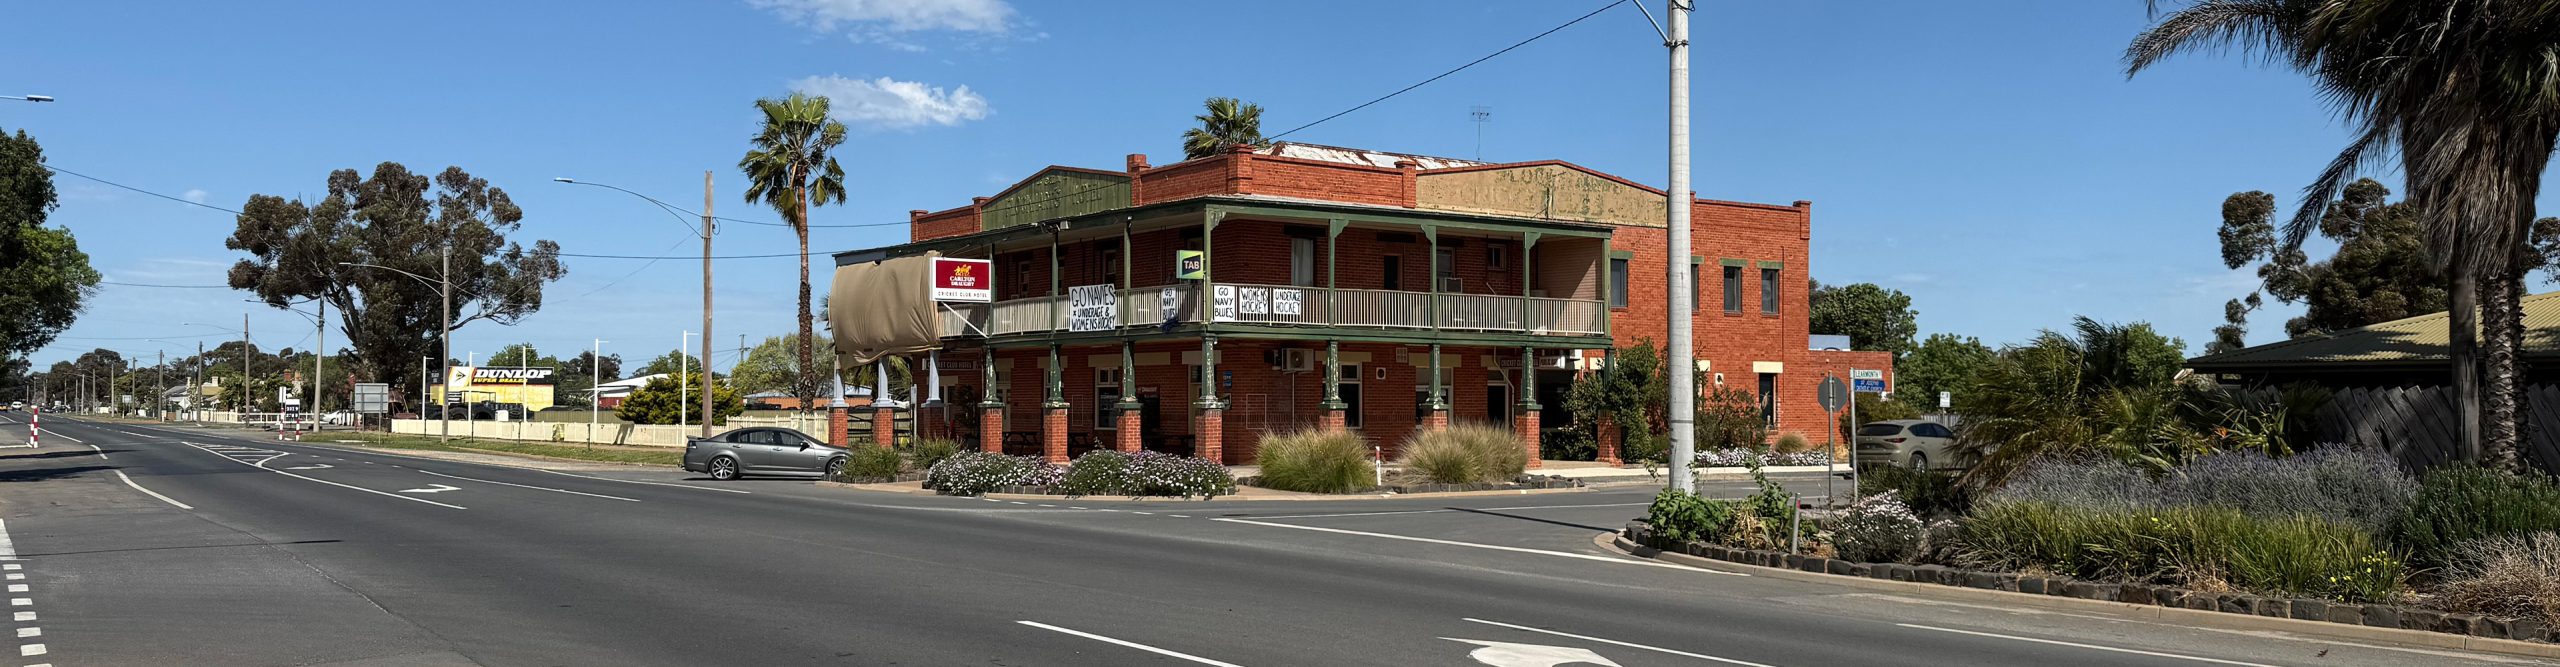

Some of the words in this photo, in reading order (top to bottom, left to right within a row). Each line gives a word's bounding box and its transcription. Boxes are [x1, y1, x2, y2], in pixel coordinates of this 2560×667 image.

[1184, 261, 1199, 269] TAB
[1071, 287, 1087, 307] GO
[1087, 284, 1116, 306] NAVIES
[1165, 288, 1173, 297] GO
[1218, 287, 1229, 296] GO
[1275, 290, 1301, 302] UNDERAGE
[1163, 297, 1175, 307] NAVY
[1215, 297, 1234, 306] NAVY
[1077, 306, 1104, 318] UNDERAGE
[1105, 306, 1110, 317] &
[1214, 307, 1234, 318] BLUES
[1241, 301, 1268, 314] HOCKEY
[1275, 301, 1300, 314] HOCKEY
[1098, 314, 1116, 329] HOCKEY
[475, 369, 552, 378] DUNLOP
